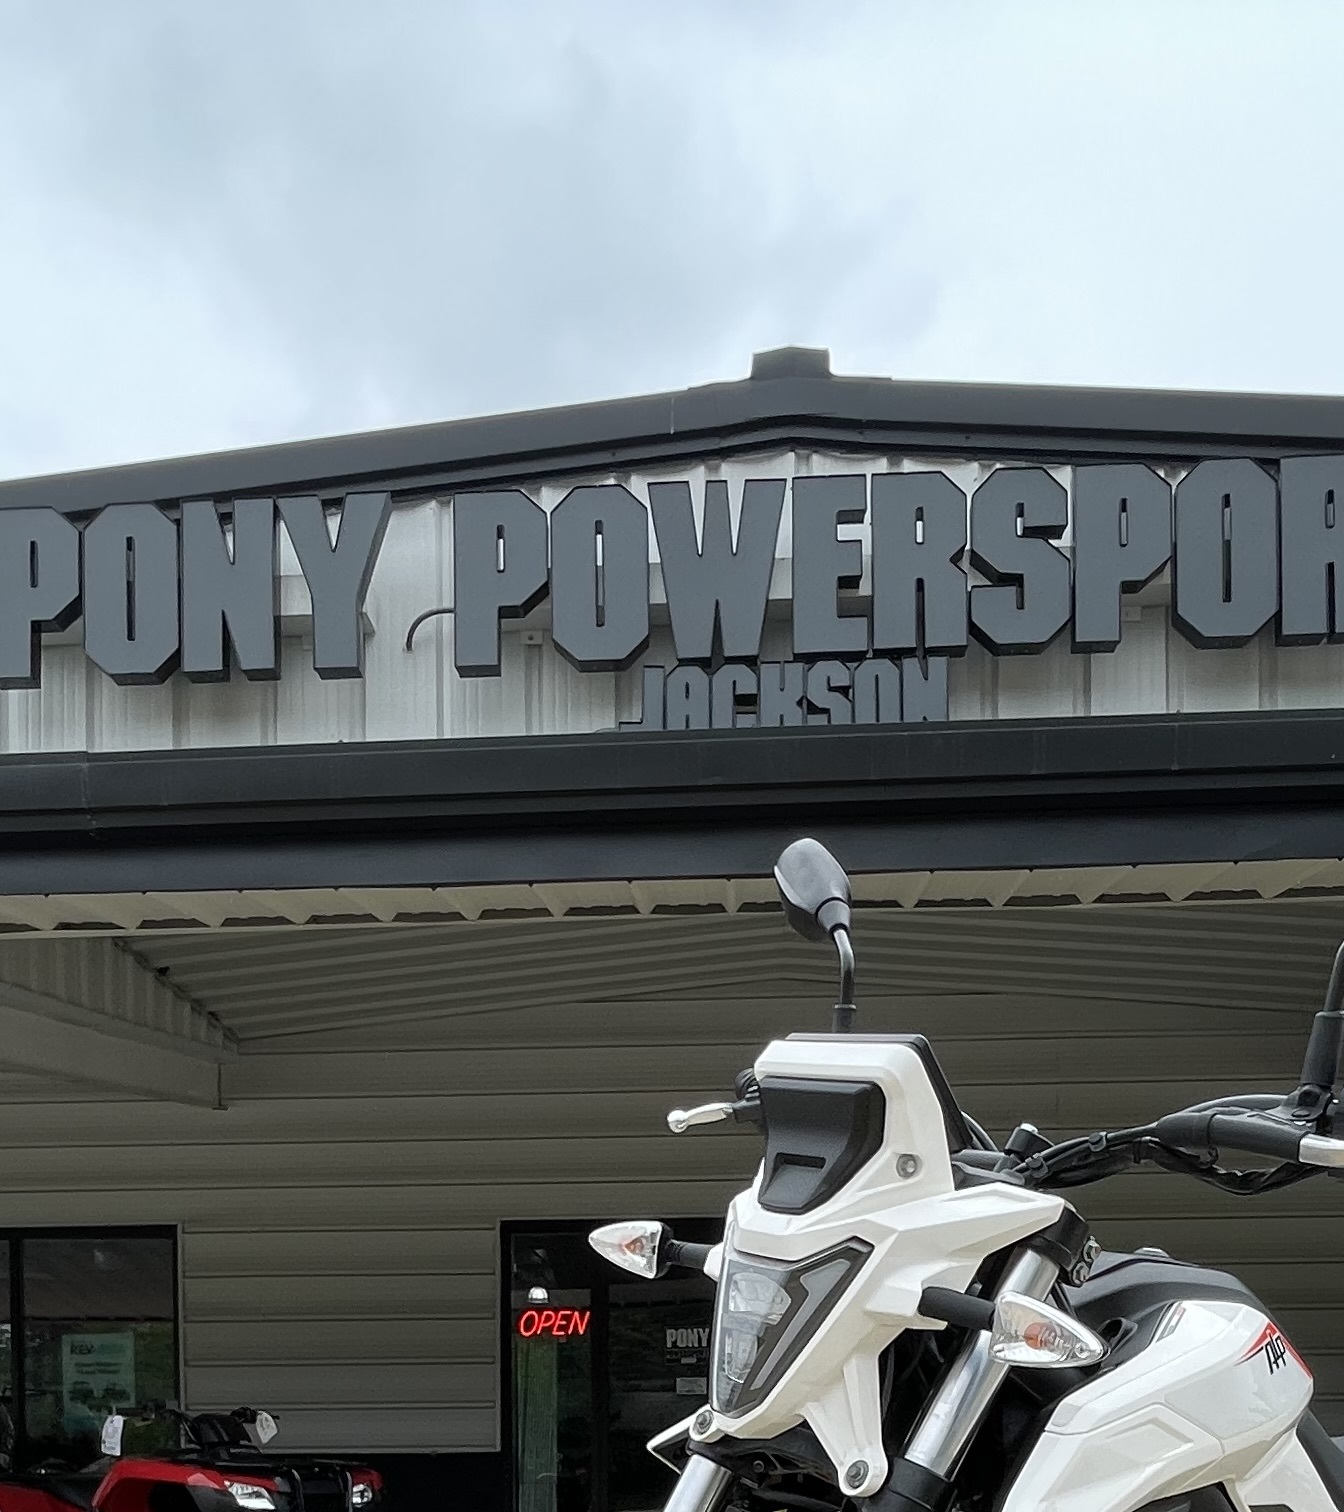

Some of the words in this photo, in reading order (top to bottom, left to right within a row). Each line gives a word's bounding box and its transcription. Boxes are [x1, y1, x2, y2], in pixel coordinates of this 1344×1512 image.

[619, 655, 950, 731] JACKSON
[520, 1310, 591, 1337] OPEN
[666, 1327, 710, 1348] PONY
